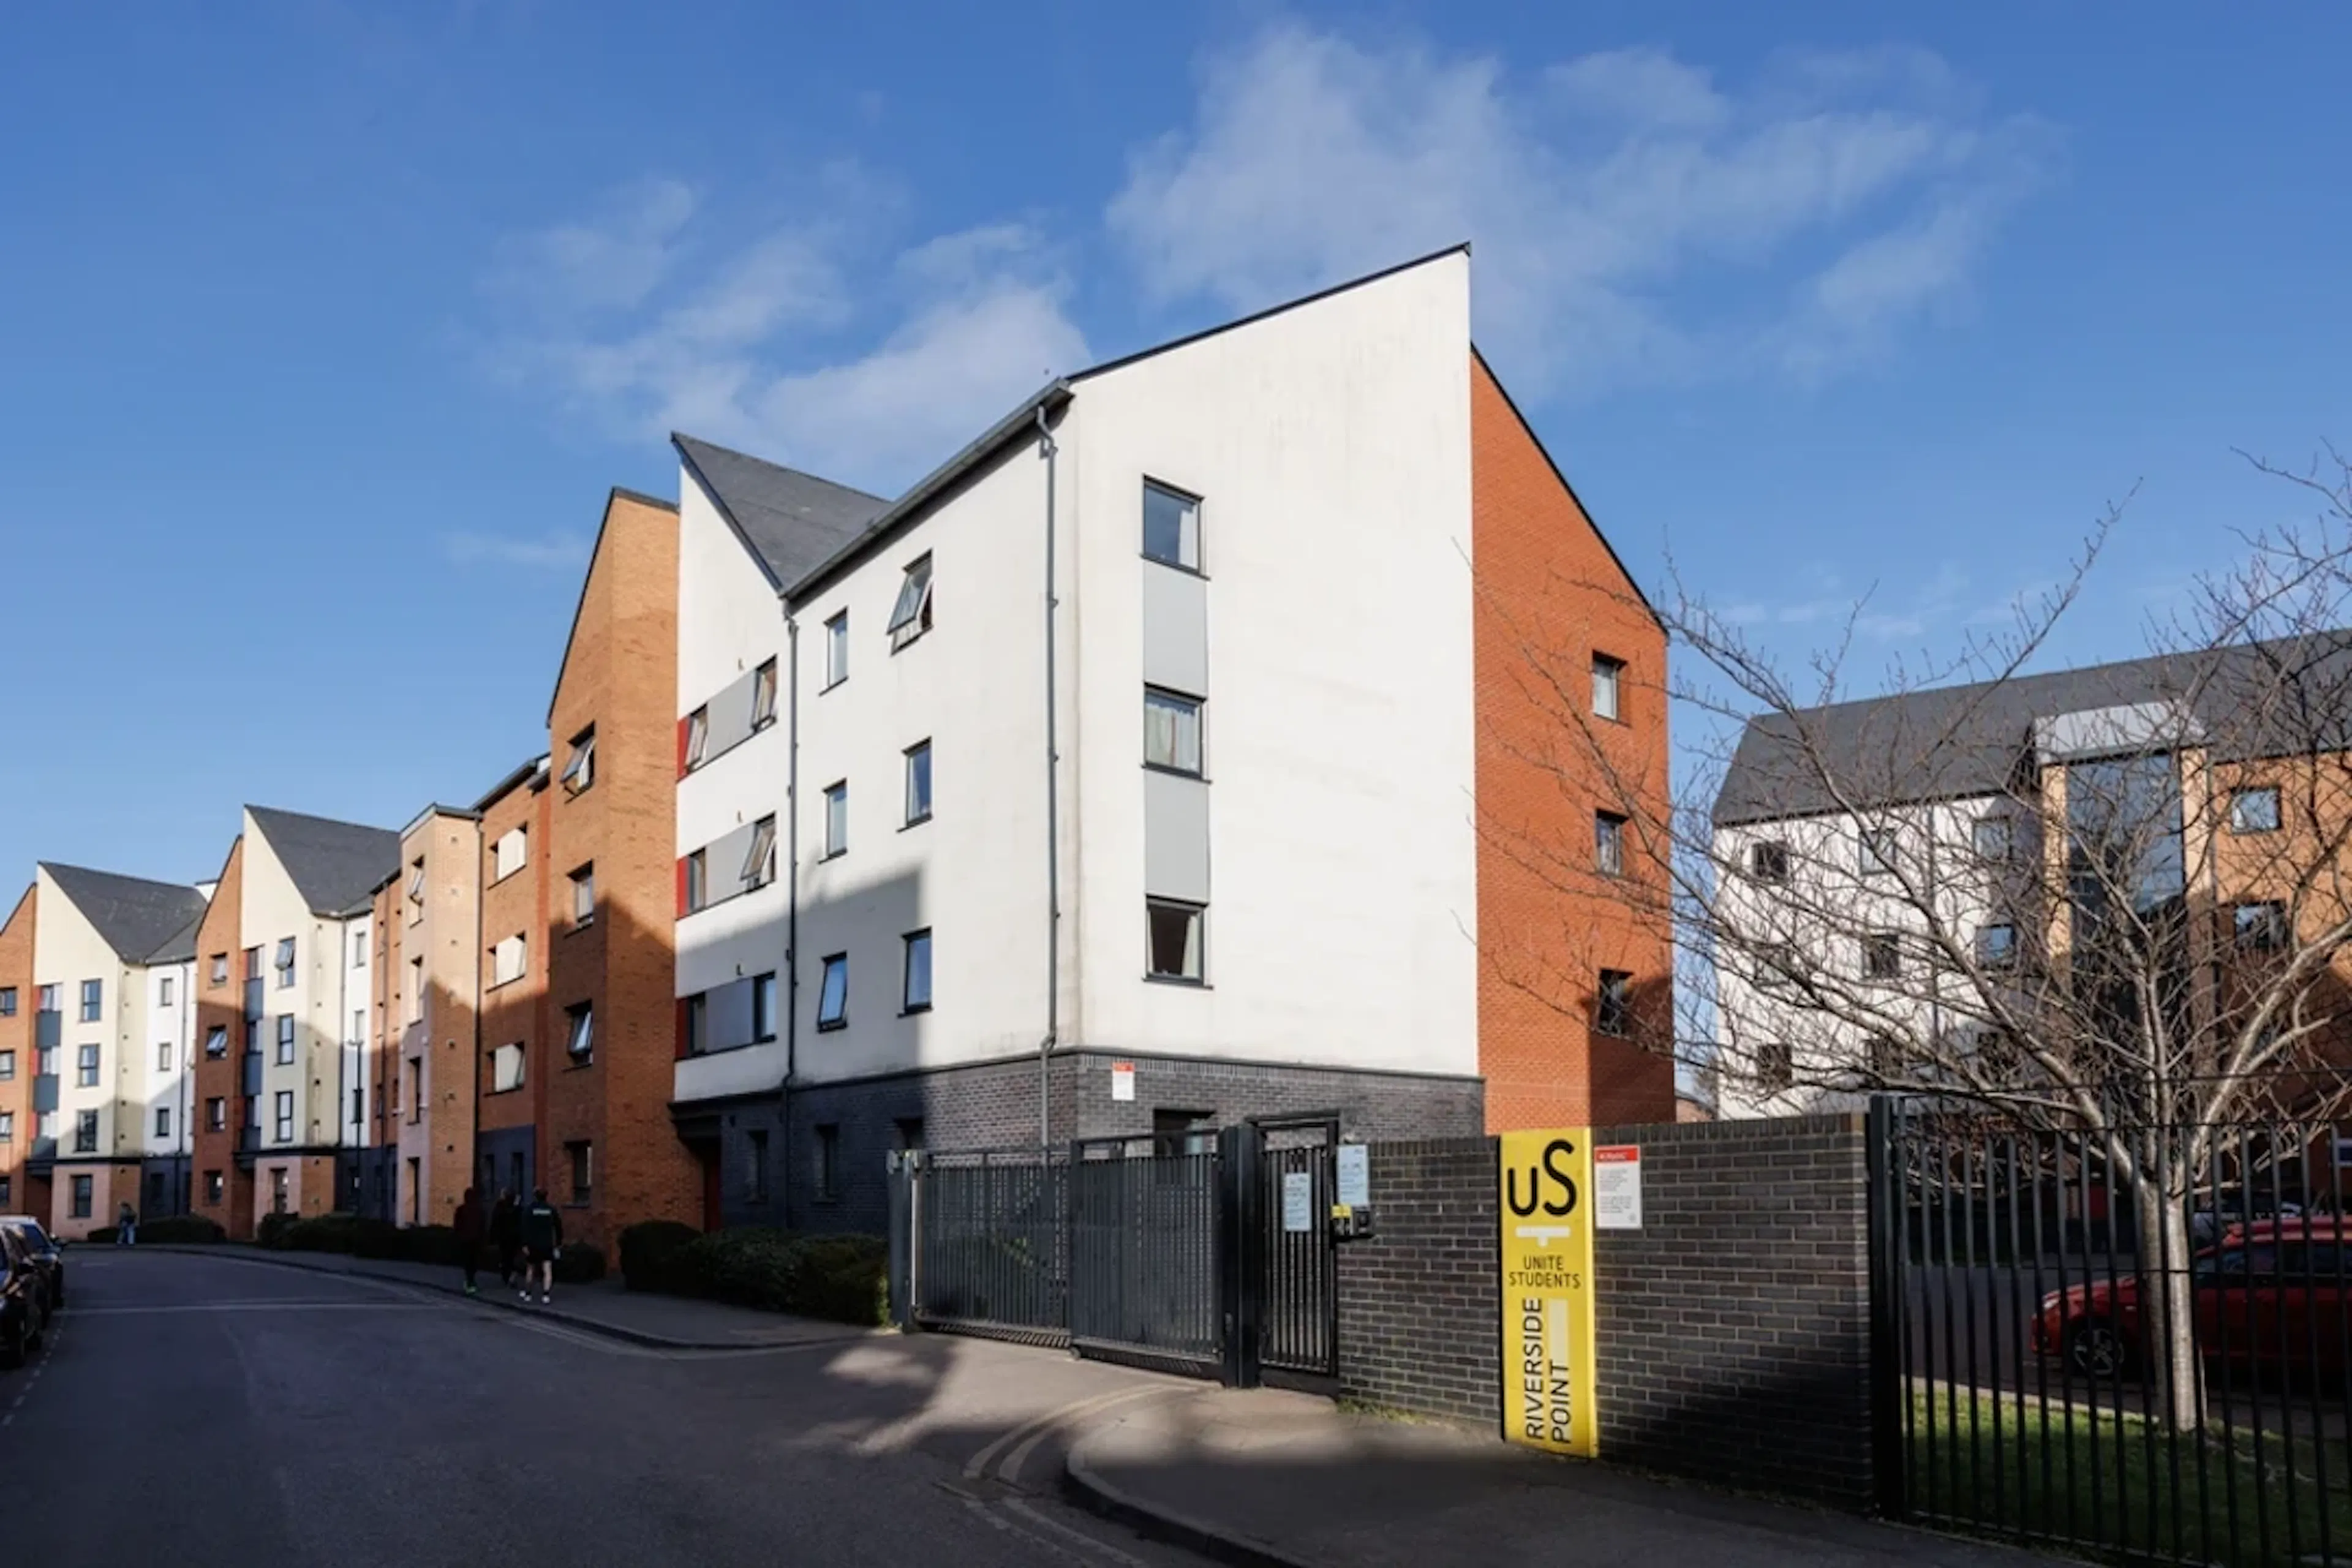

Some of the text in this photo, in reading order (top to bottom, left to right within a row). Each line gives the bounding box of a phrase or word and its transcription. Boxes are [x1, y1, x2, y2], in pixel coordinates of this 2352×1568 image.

[1509, 1272, 1581, 1289] STUDENTS
[1523, 1255, 1564, 1272] UNITE
[1523, 1298, 1545, 1440] RIVERSIDE
[1549, 1359, 1572, 1444] POINT
